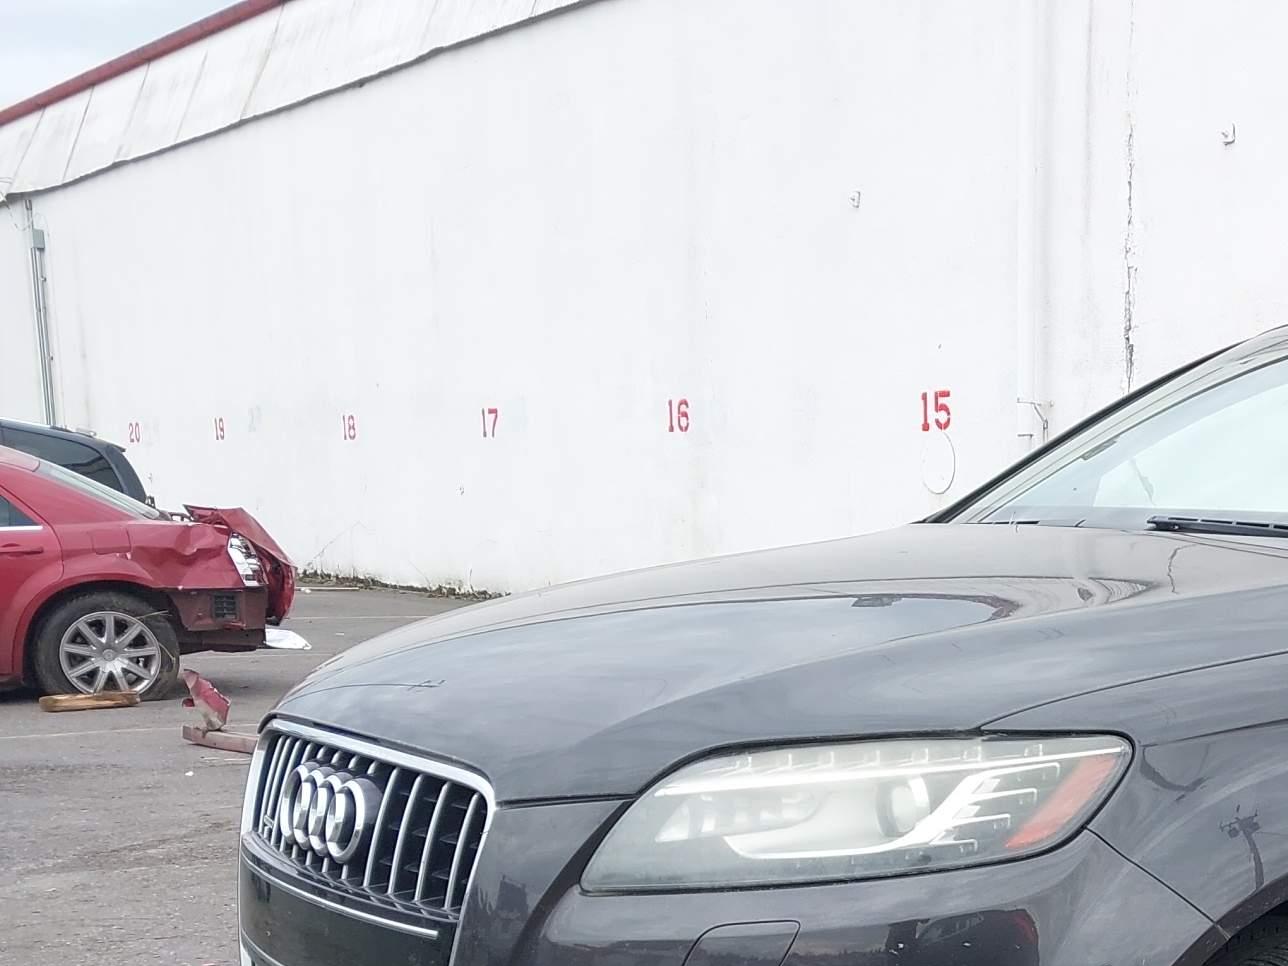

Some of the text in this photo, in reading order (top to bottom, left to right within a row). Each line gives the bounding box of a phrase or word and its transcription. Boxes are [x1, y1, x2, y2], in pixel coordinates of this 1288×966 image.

[481, 407, 499, 438] 17
[667, 398, 690, 433] 16
[921, 390, 951, 431] 15
[128, 421, 141, 443] 20
[213, 417, 225, 440] 19
[342, 415, 357, 440] 18
